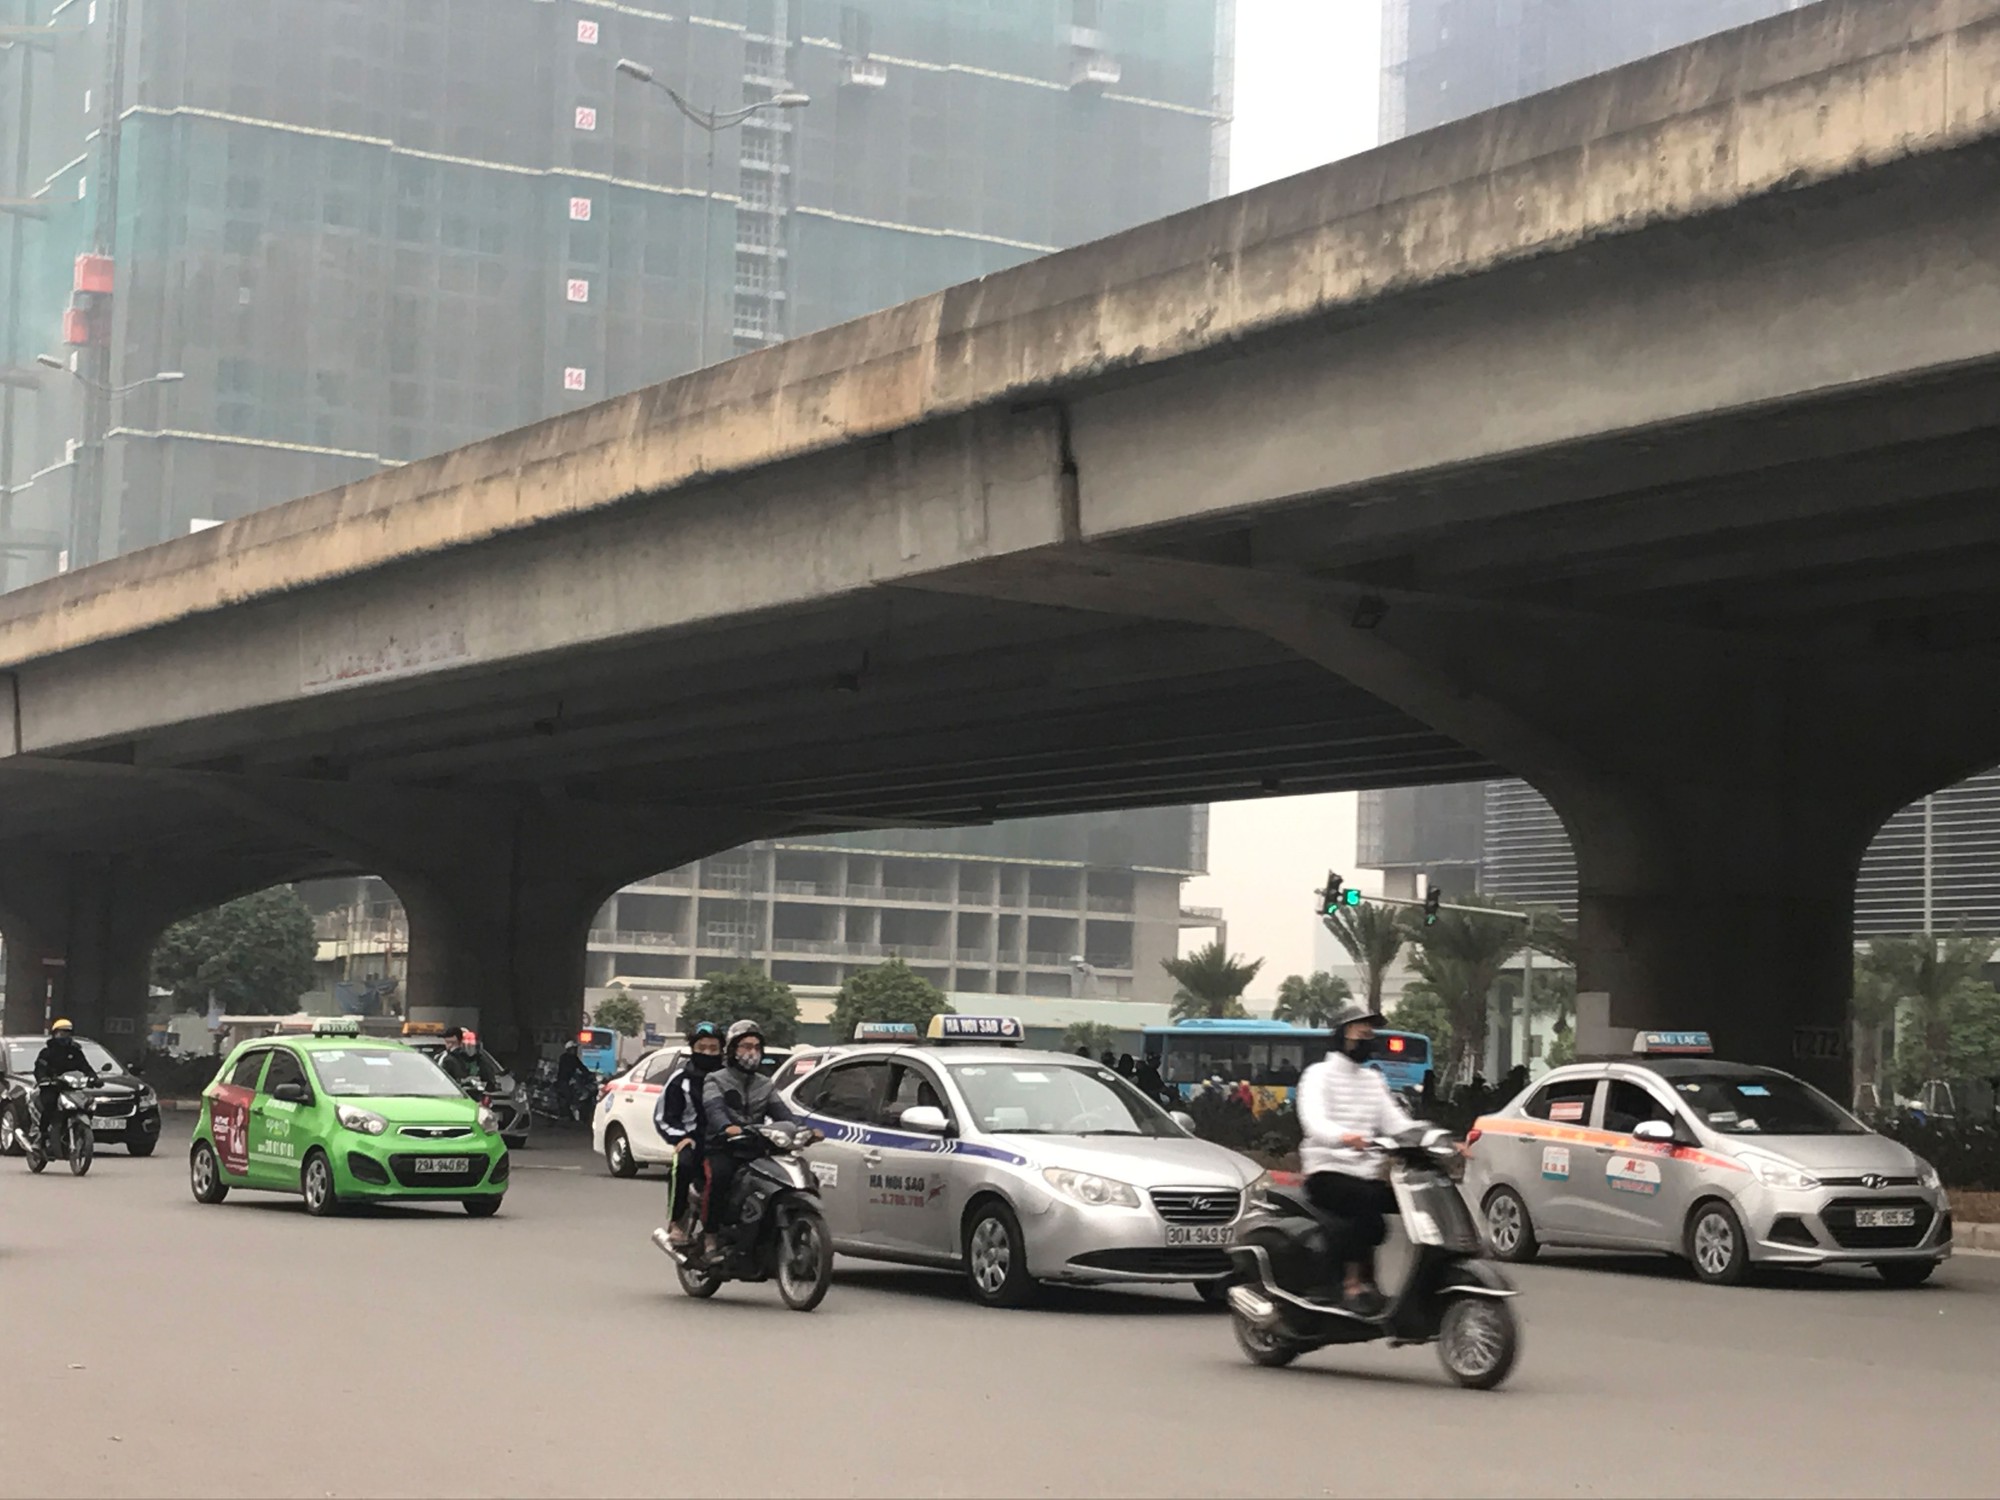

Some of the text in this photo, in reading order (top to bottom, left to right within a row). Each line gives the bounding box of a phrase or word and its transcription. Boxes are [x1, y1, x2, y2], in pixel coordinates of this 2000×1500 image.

[580, 23, 596, 40] 22
[578, 109, 594, 127] 20
[573, 201, 588, 218] 18
[570, 282, 586, 299] 16
[567, 371, 583, 387] 14
[979, 1019, 999, 1034] SAO
[904, 1176, 925, 1192] SAO
